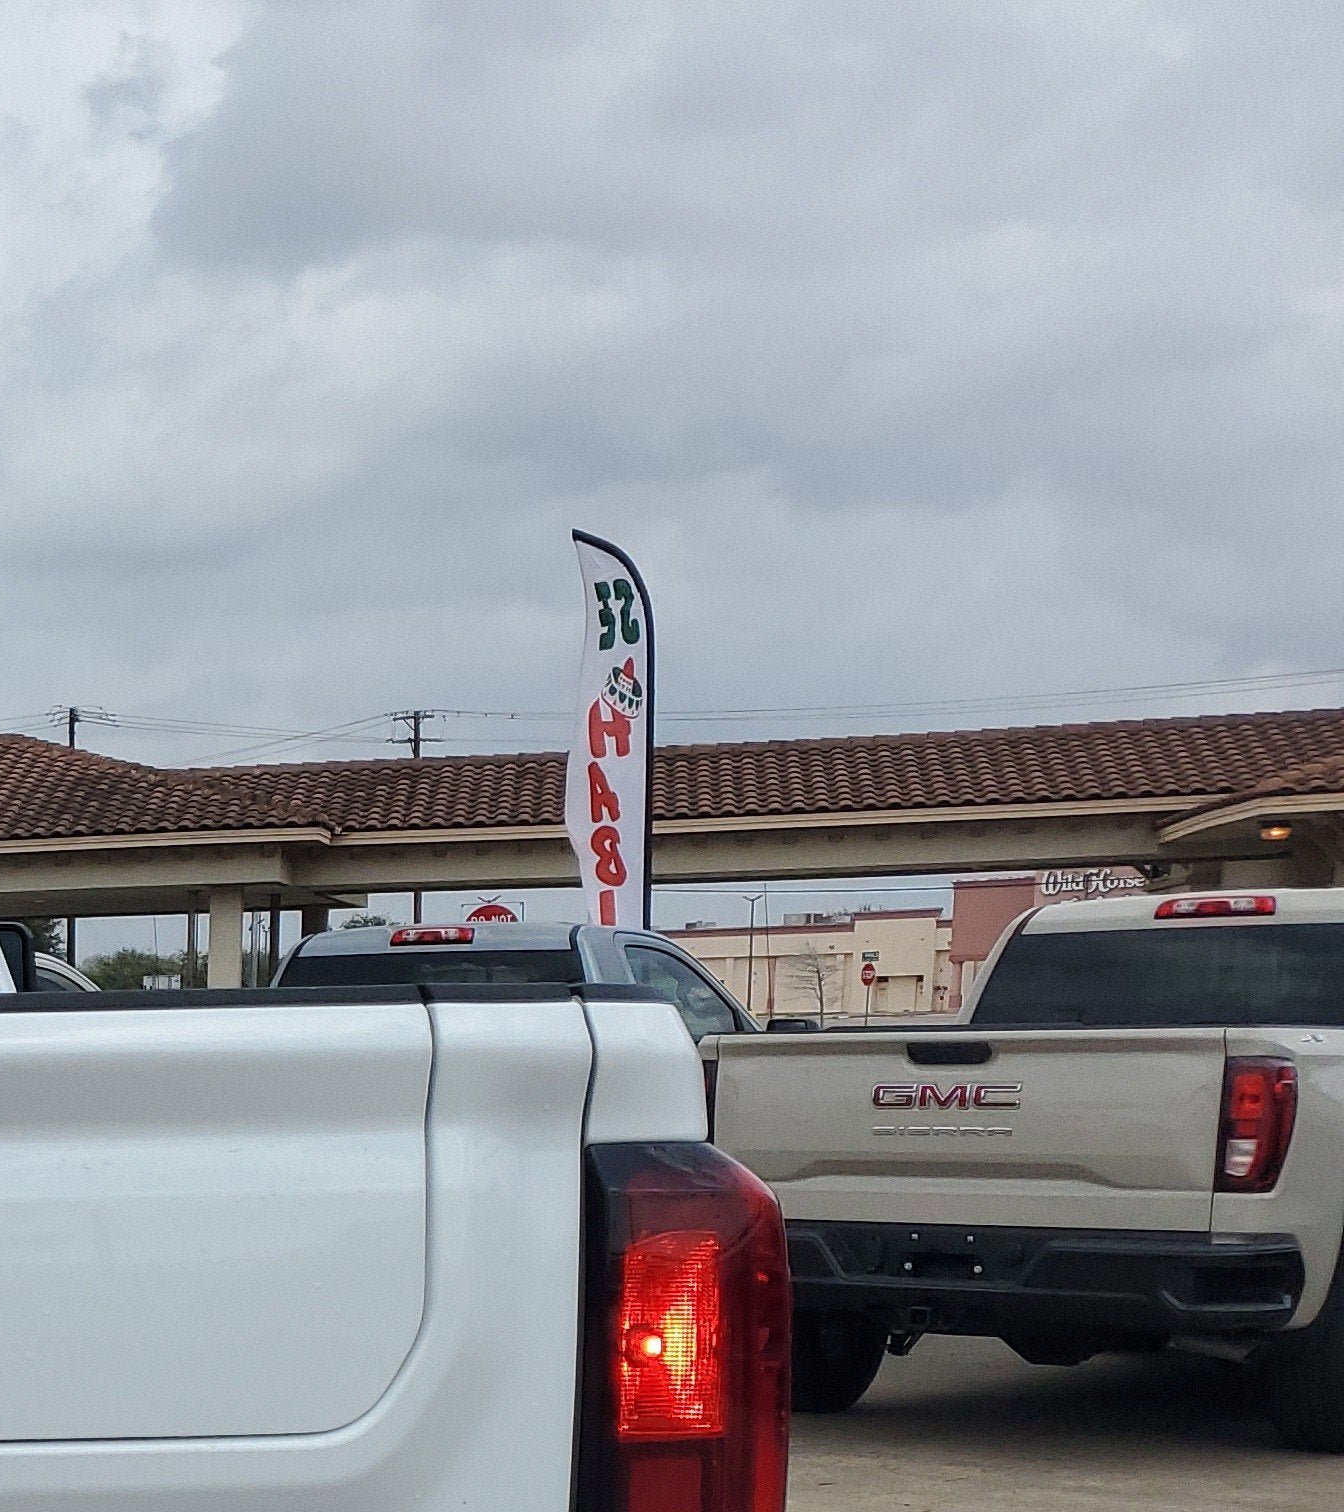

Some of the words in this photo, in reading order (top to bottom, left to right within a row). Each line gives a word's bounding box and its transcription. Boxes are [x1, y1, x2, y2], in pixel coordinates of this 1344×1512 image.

[1040, 869, 1085, 895] Wild
[1084, 867, 1146, 893] Horse
[872, 1082, 1023, 1110] GMC
[872, 1125, 1013, 1137] SIERRA
